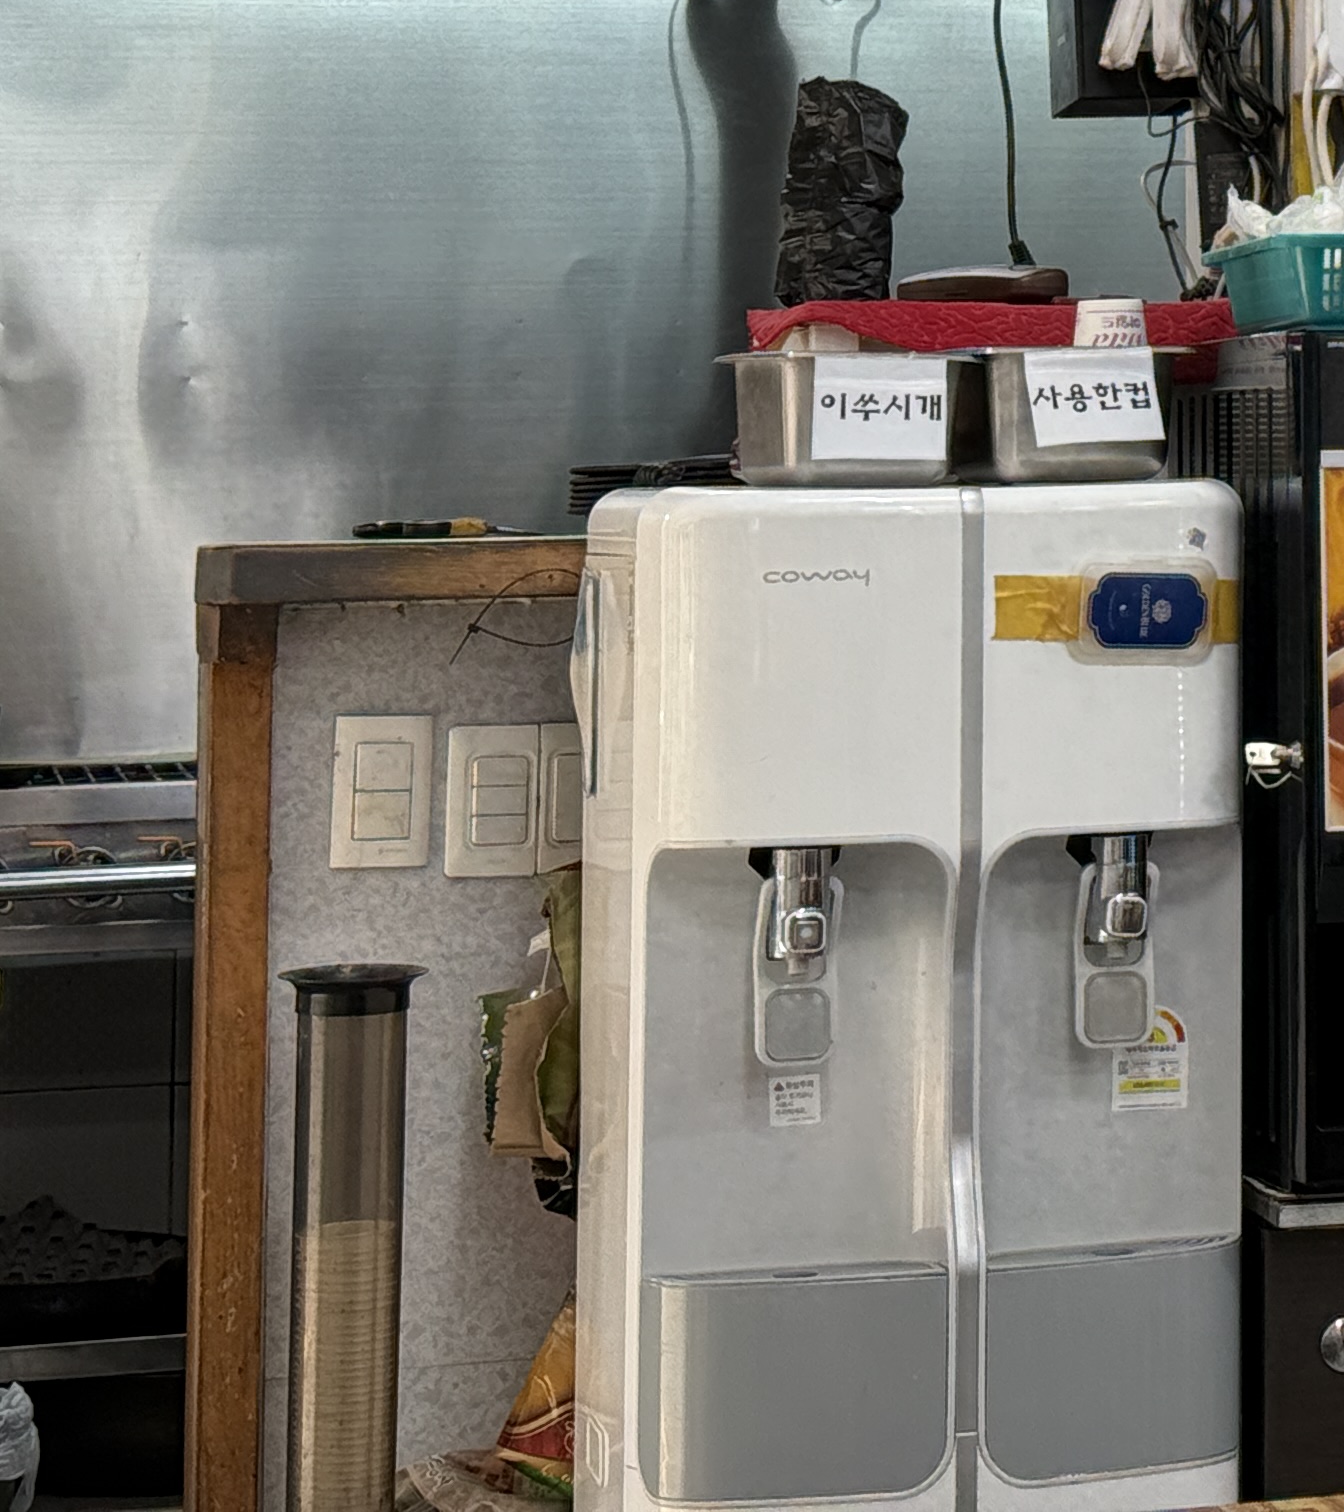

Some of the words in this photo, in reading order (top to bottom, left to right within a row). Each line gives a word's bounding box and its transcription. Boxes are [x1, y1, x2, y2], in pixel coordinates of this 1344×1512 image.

[819, 392, 942, 422] 이쑤시개
[1031, 380, 1152, 414] 사용한컵
[762, 568, 871, 586] coway
